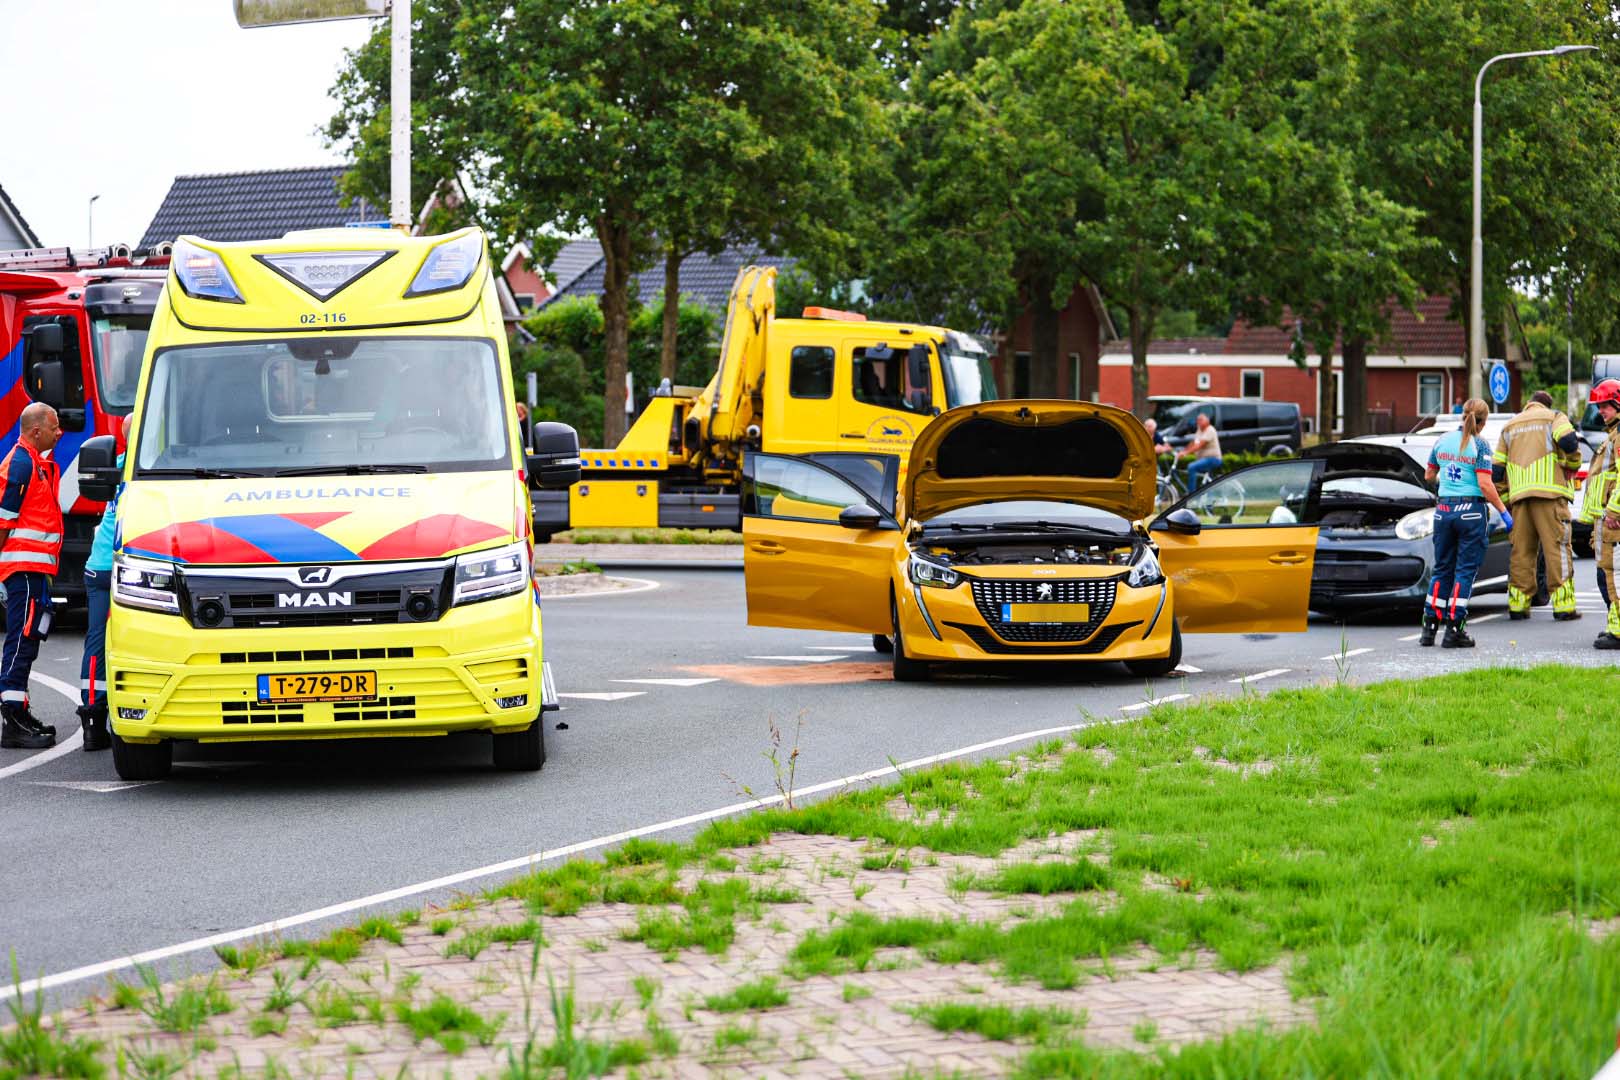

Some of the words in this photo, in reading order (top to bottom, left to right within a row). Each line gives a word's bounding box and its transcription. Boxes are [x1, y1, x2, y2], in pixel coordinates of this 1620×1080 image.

[300, 313, 346, 325] 02-116
[224, 487, 412, 504] AMBULANCE
[279, 592, 351, 607] MAN
[275, 675, 367, 695] T-279-DR
